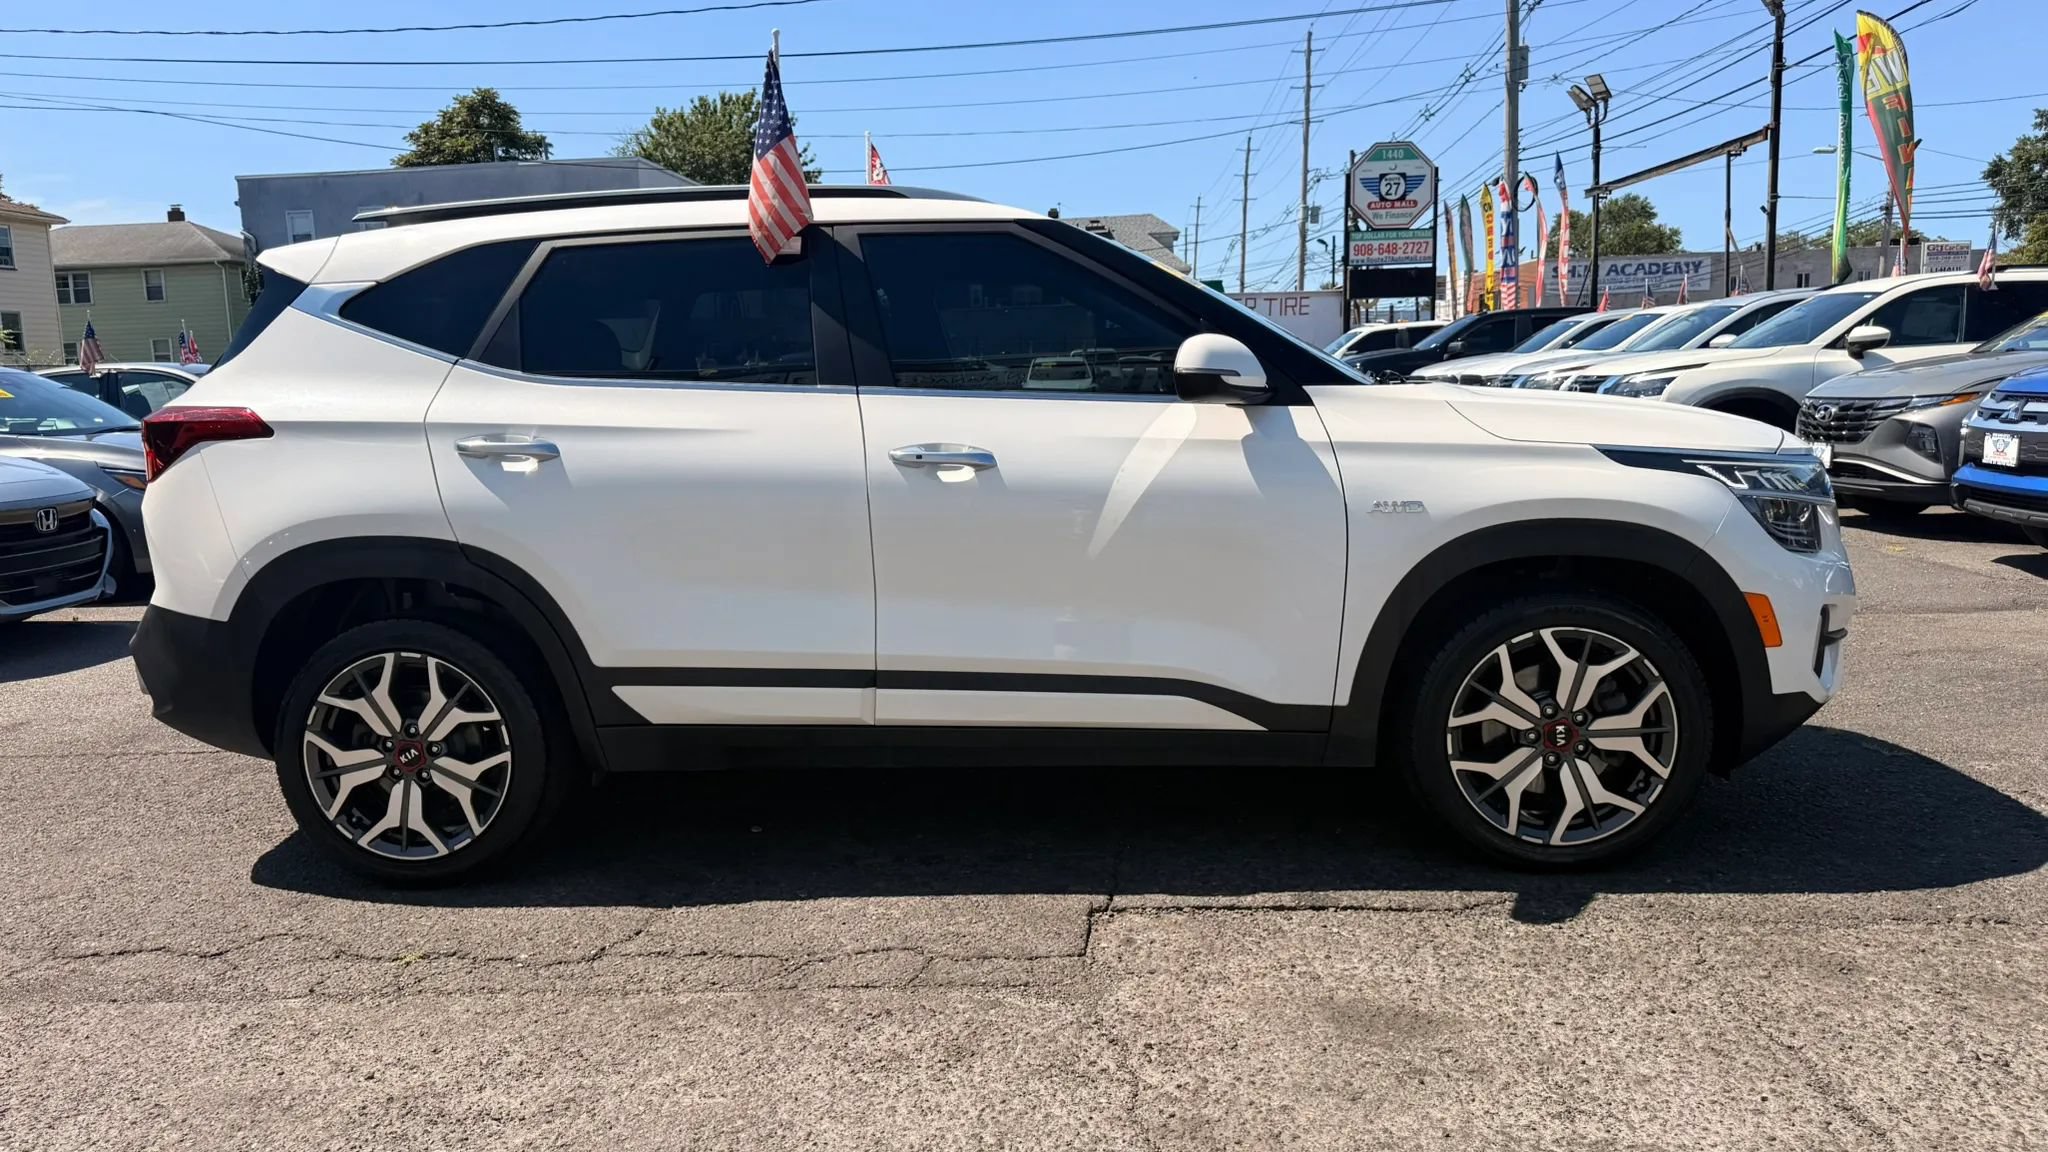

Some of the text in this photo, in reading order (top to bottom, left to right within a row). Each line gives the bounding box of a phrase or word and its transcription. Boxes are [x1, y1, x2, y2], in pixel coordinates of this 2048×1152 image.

[1381, 149, 1405, 159] 1440
[1384, 182, 1401, 197] 27
[1372, 210, 1414, 220] We Finance
[1353, 241, 1429, 257] 908-648-2727
[1606, 260, 1703, 276] ACADEMY
[1263, 296, 1310, 316] TIRE
[1367, 500, 1424, 513] AWD
[1556, 725, 1566, 746] KIA
[400, 749, 419, 764] KIA
